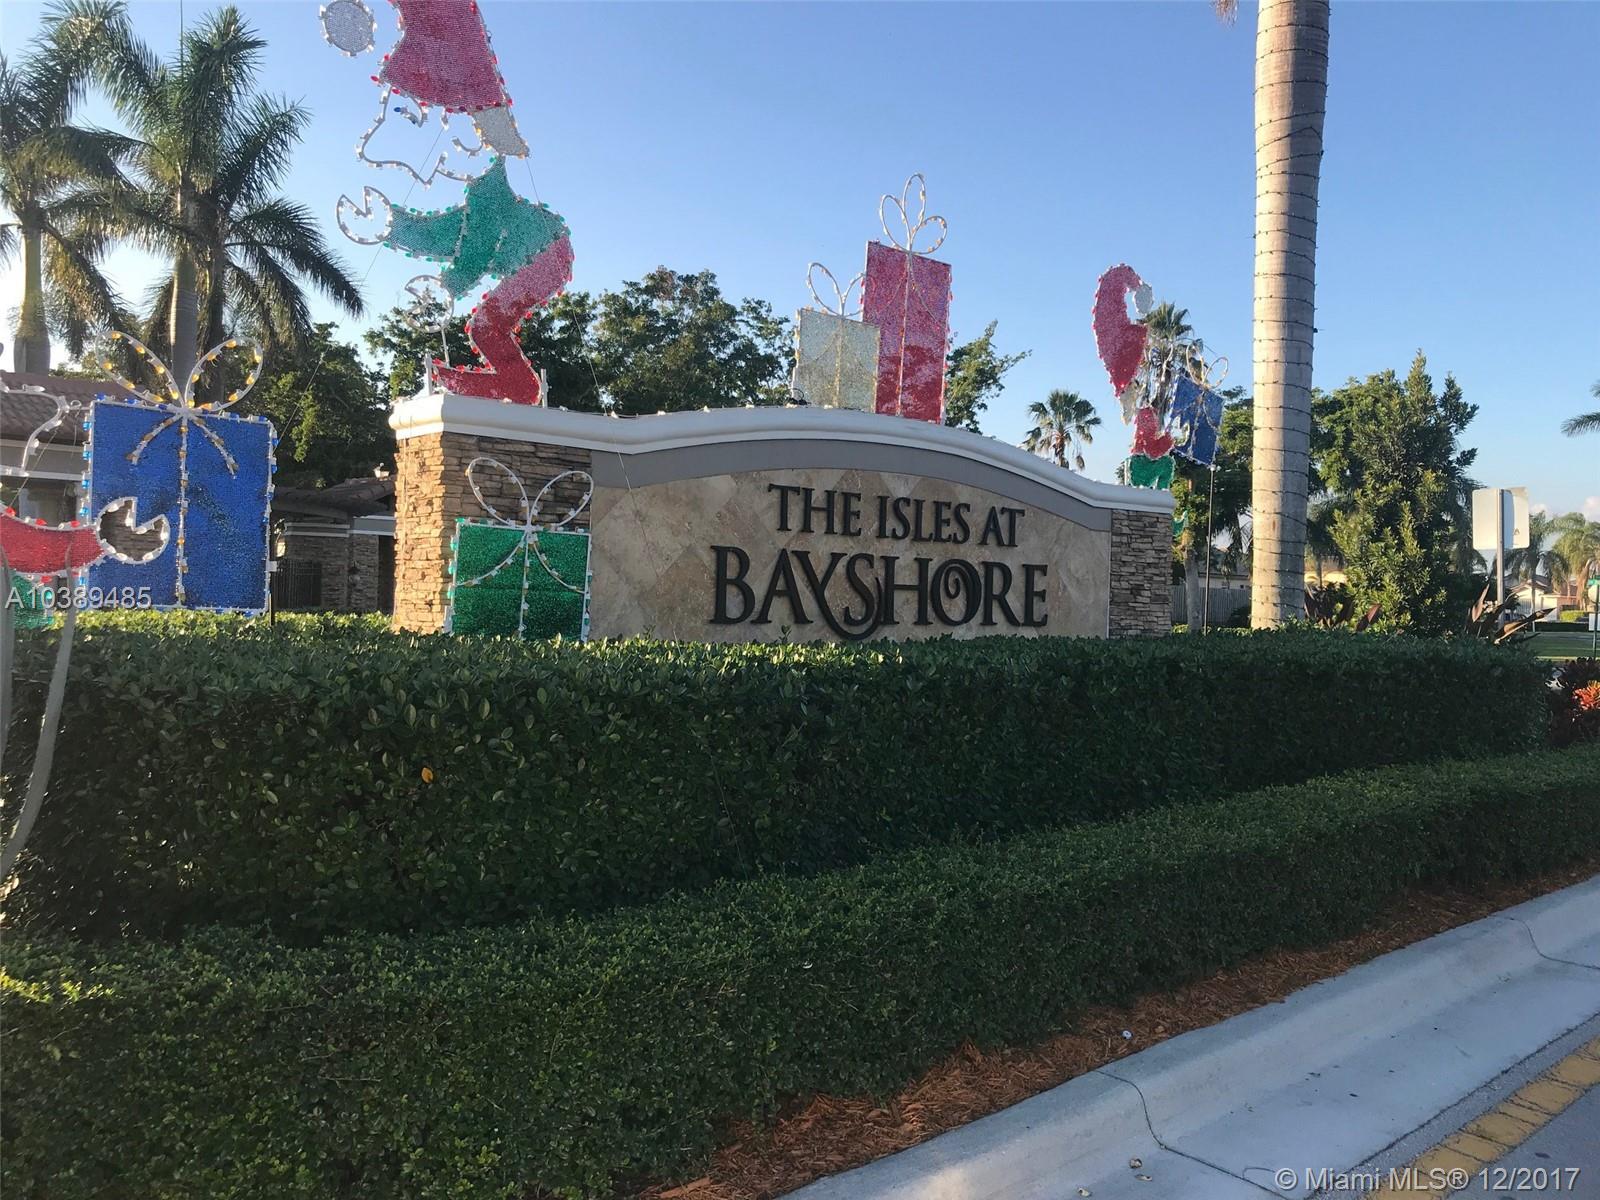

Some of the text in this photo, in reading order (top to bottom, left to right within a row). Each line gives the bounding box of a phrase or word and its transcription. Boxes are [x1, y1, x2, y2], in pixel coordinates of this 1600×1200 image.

[767, 483, 1025, 547] THE ISLES AT
[709, 545, 1048, 640] BAYSHORE
